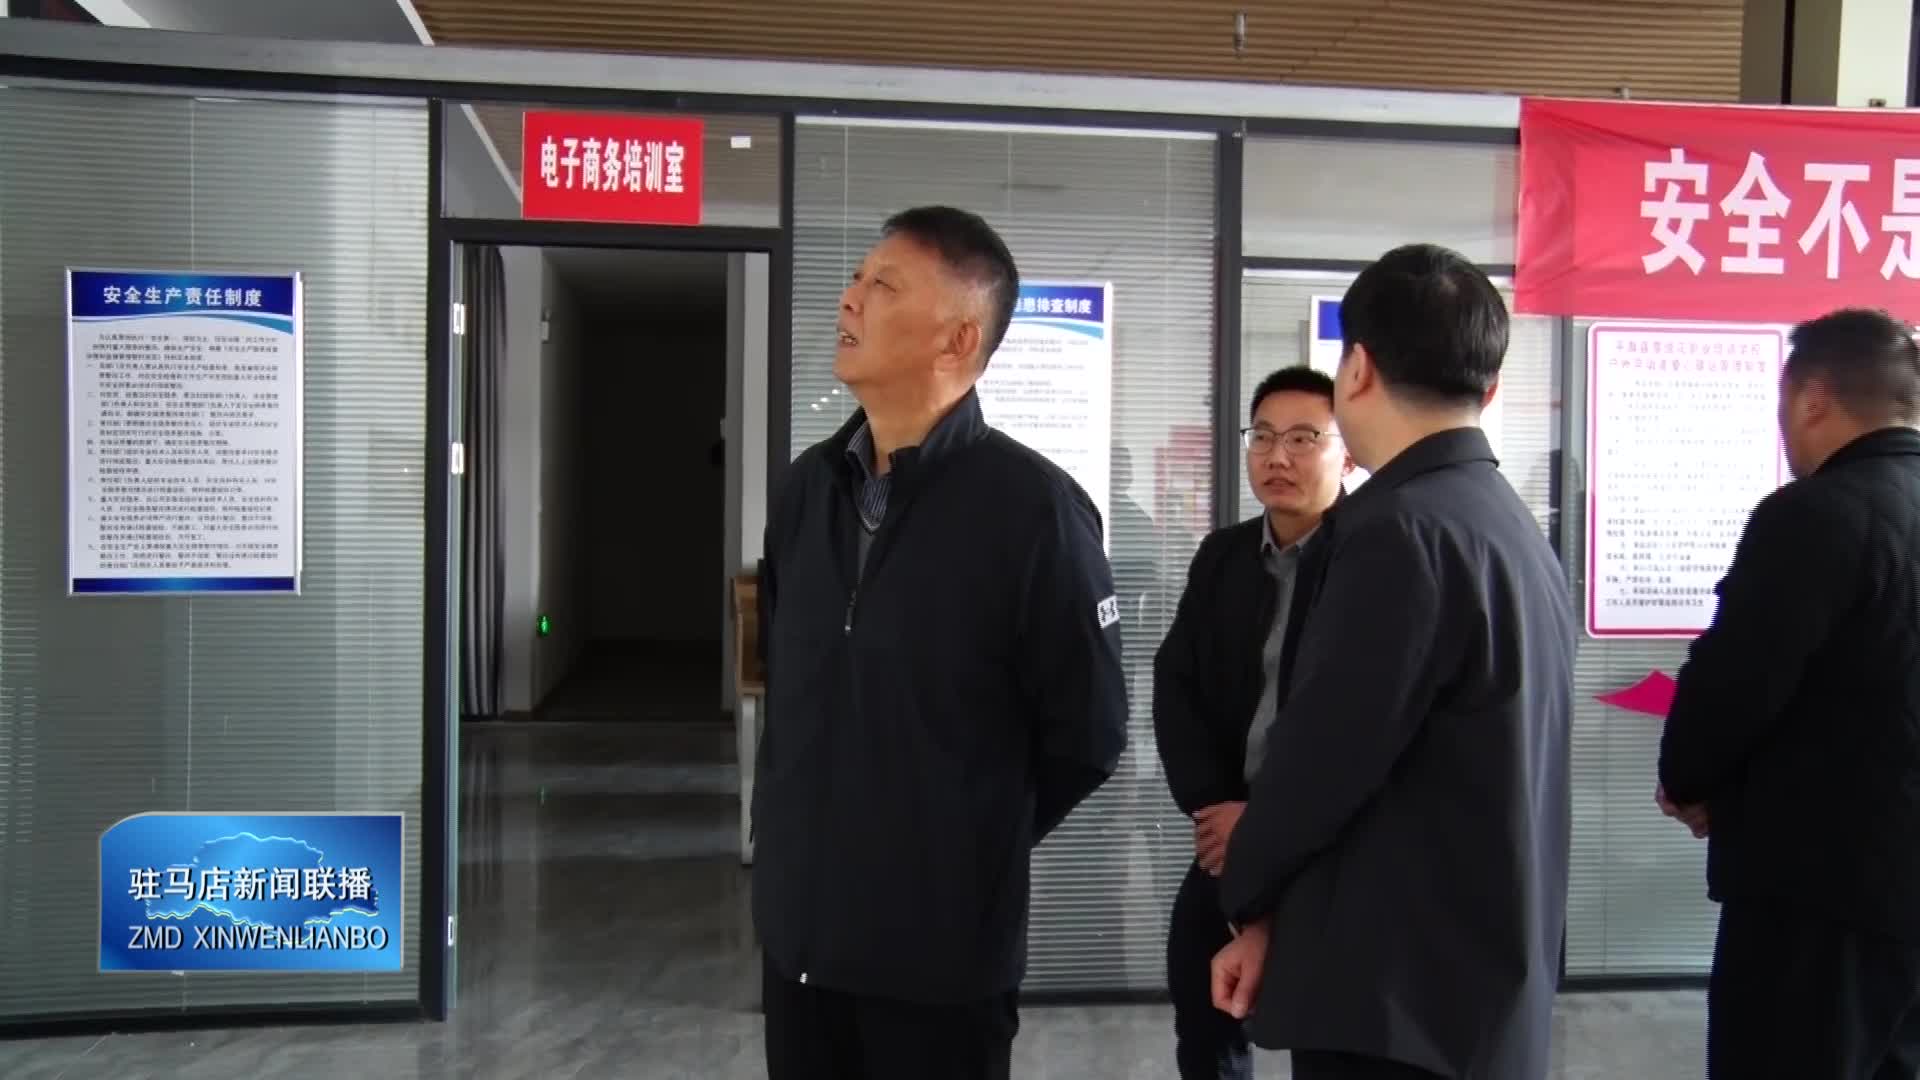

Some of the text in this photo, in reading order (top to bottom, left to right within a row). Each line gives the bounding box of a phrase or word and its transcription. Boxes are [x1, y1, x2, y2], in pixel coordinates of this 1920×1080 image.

[540, 135, 684, 193] 电子商务培训室
[103, 285, 263, 307] 安全生产责任制度
